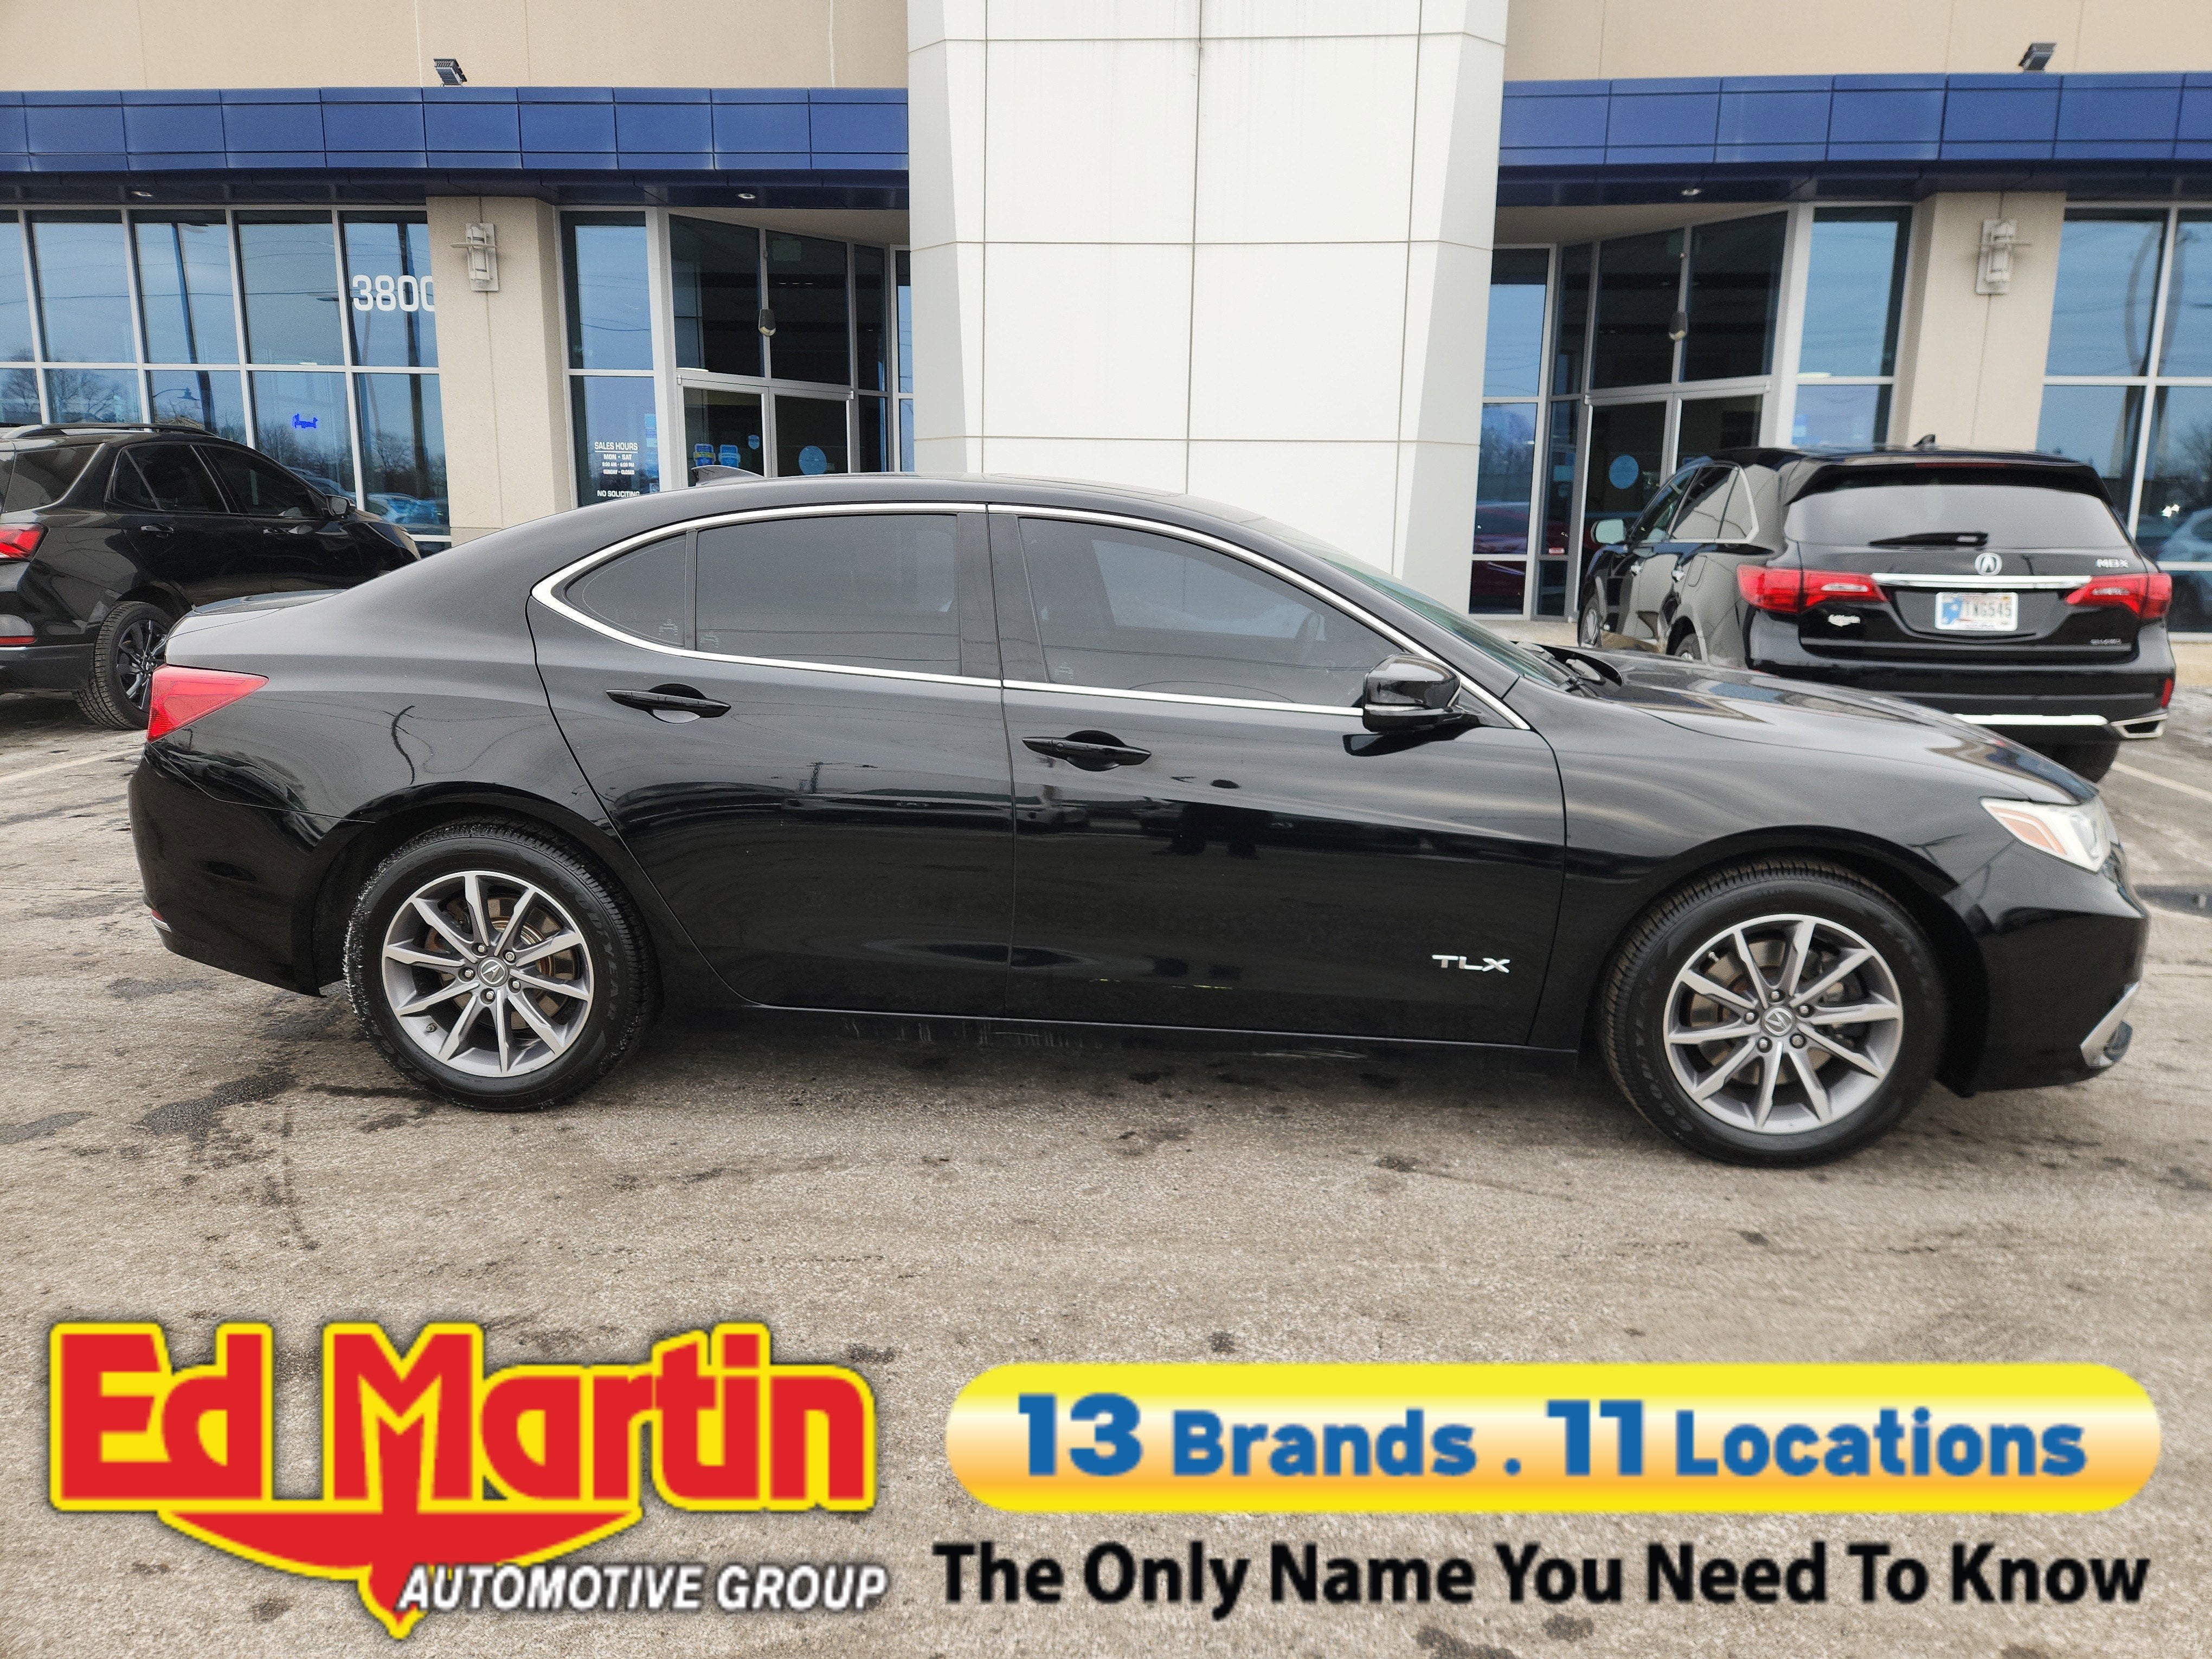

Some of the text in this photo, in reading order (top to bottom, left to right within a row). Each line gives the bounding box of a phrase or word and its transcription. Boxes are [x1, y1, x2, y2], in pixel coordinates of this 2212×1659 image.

[352, 275, 434, 312] 3800
[594, 441, 614, 449] SALES
[1432, 954, 1510, 973] TLX
